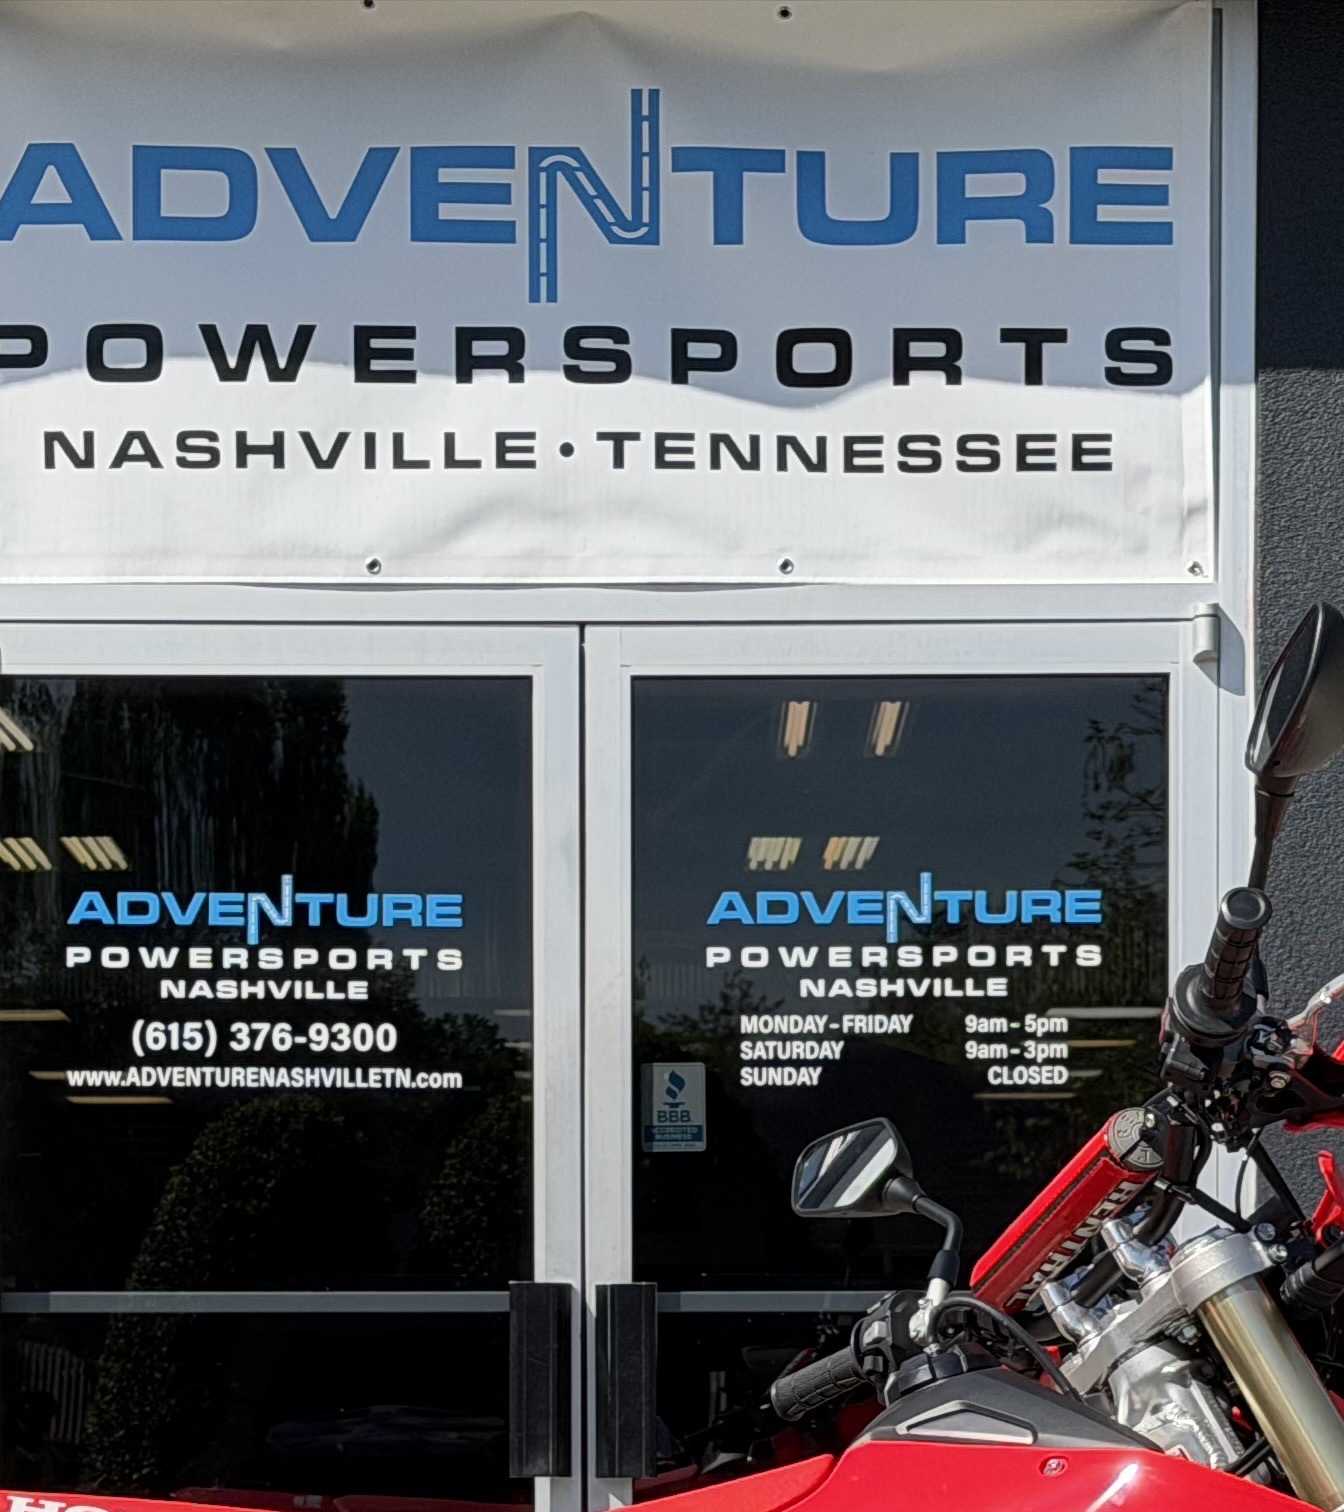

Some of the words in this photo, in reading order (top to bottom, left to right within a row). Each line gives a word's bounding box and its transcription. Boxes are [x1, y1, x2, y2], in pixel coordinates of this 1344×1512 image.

[67, 874, 464, 945] ADVENTURE
[706, 872, 1103, 944] ADVENTURE
[66, 946, 463, 971] POWERSPORTS
[705, 944, 1102, 969] POWERSPORTS
[160, 979, 369, 1001] NASHVILLE
[799, 977, 1008, 998] NASHVILLE
[131, 1018, 218, 1058] (615)
[229, 1021, 398, 1053] 376-9300
[740, 1040, 845, 1061] SATURDAY
[66, 1065, 463, 1090] www.ADVENTURENASHVILLETN.com
[740, 1066, 823, 1087] SUNDAY
[987, 1065, 1069, 1086] CLOSED
[657, 1109, 691, 1123] BBB
[1003, 1180, 1145, 1308] RENTHAL
